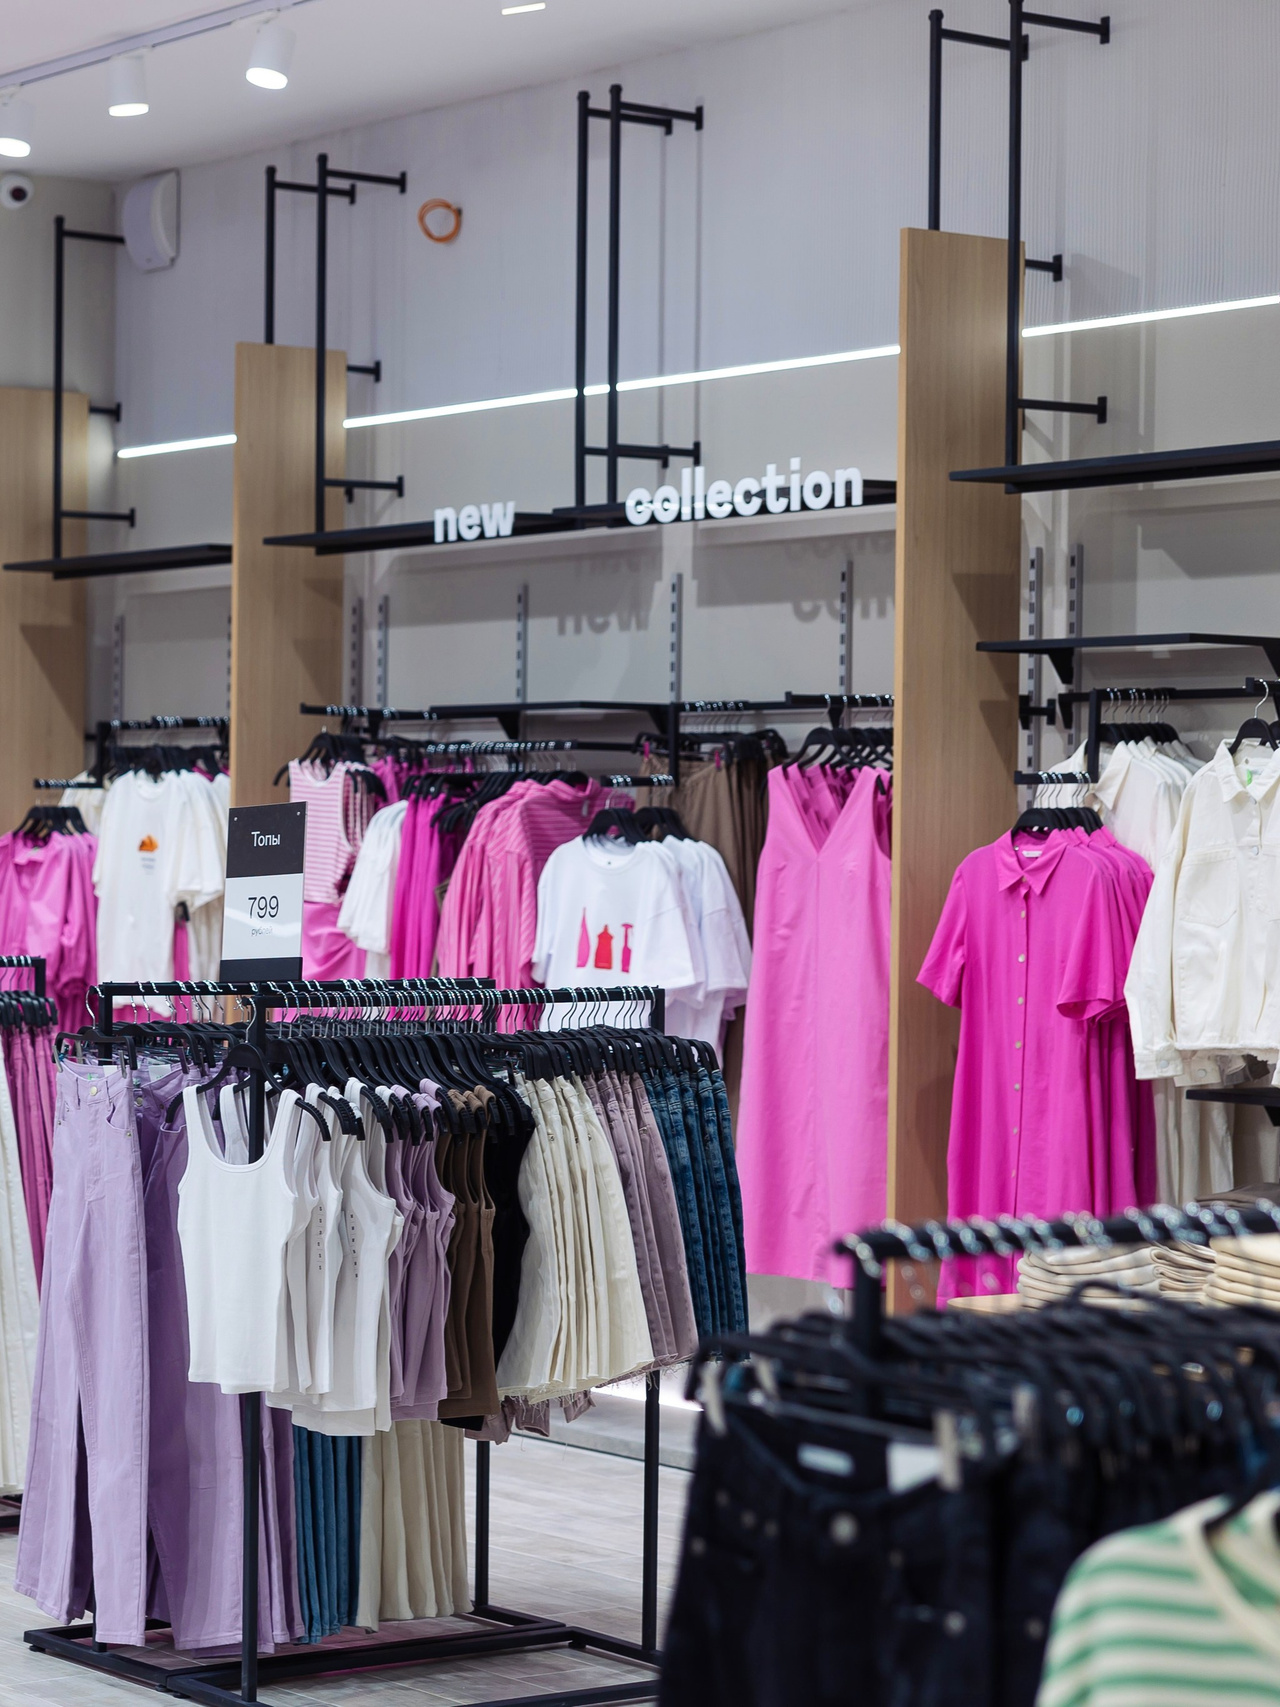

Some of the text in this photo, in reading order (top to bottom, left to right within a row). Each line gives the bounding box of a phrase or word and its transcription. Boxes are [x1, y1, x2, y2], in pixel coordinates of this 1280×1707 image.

[433, 457, 864, 544] new collection
[251, 831, 281, 847] Топы
[248, 895, 280, 919] 799
